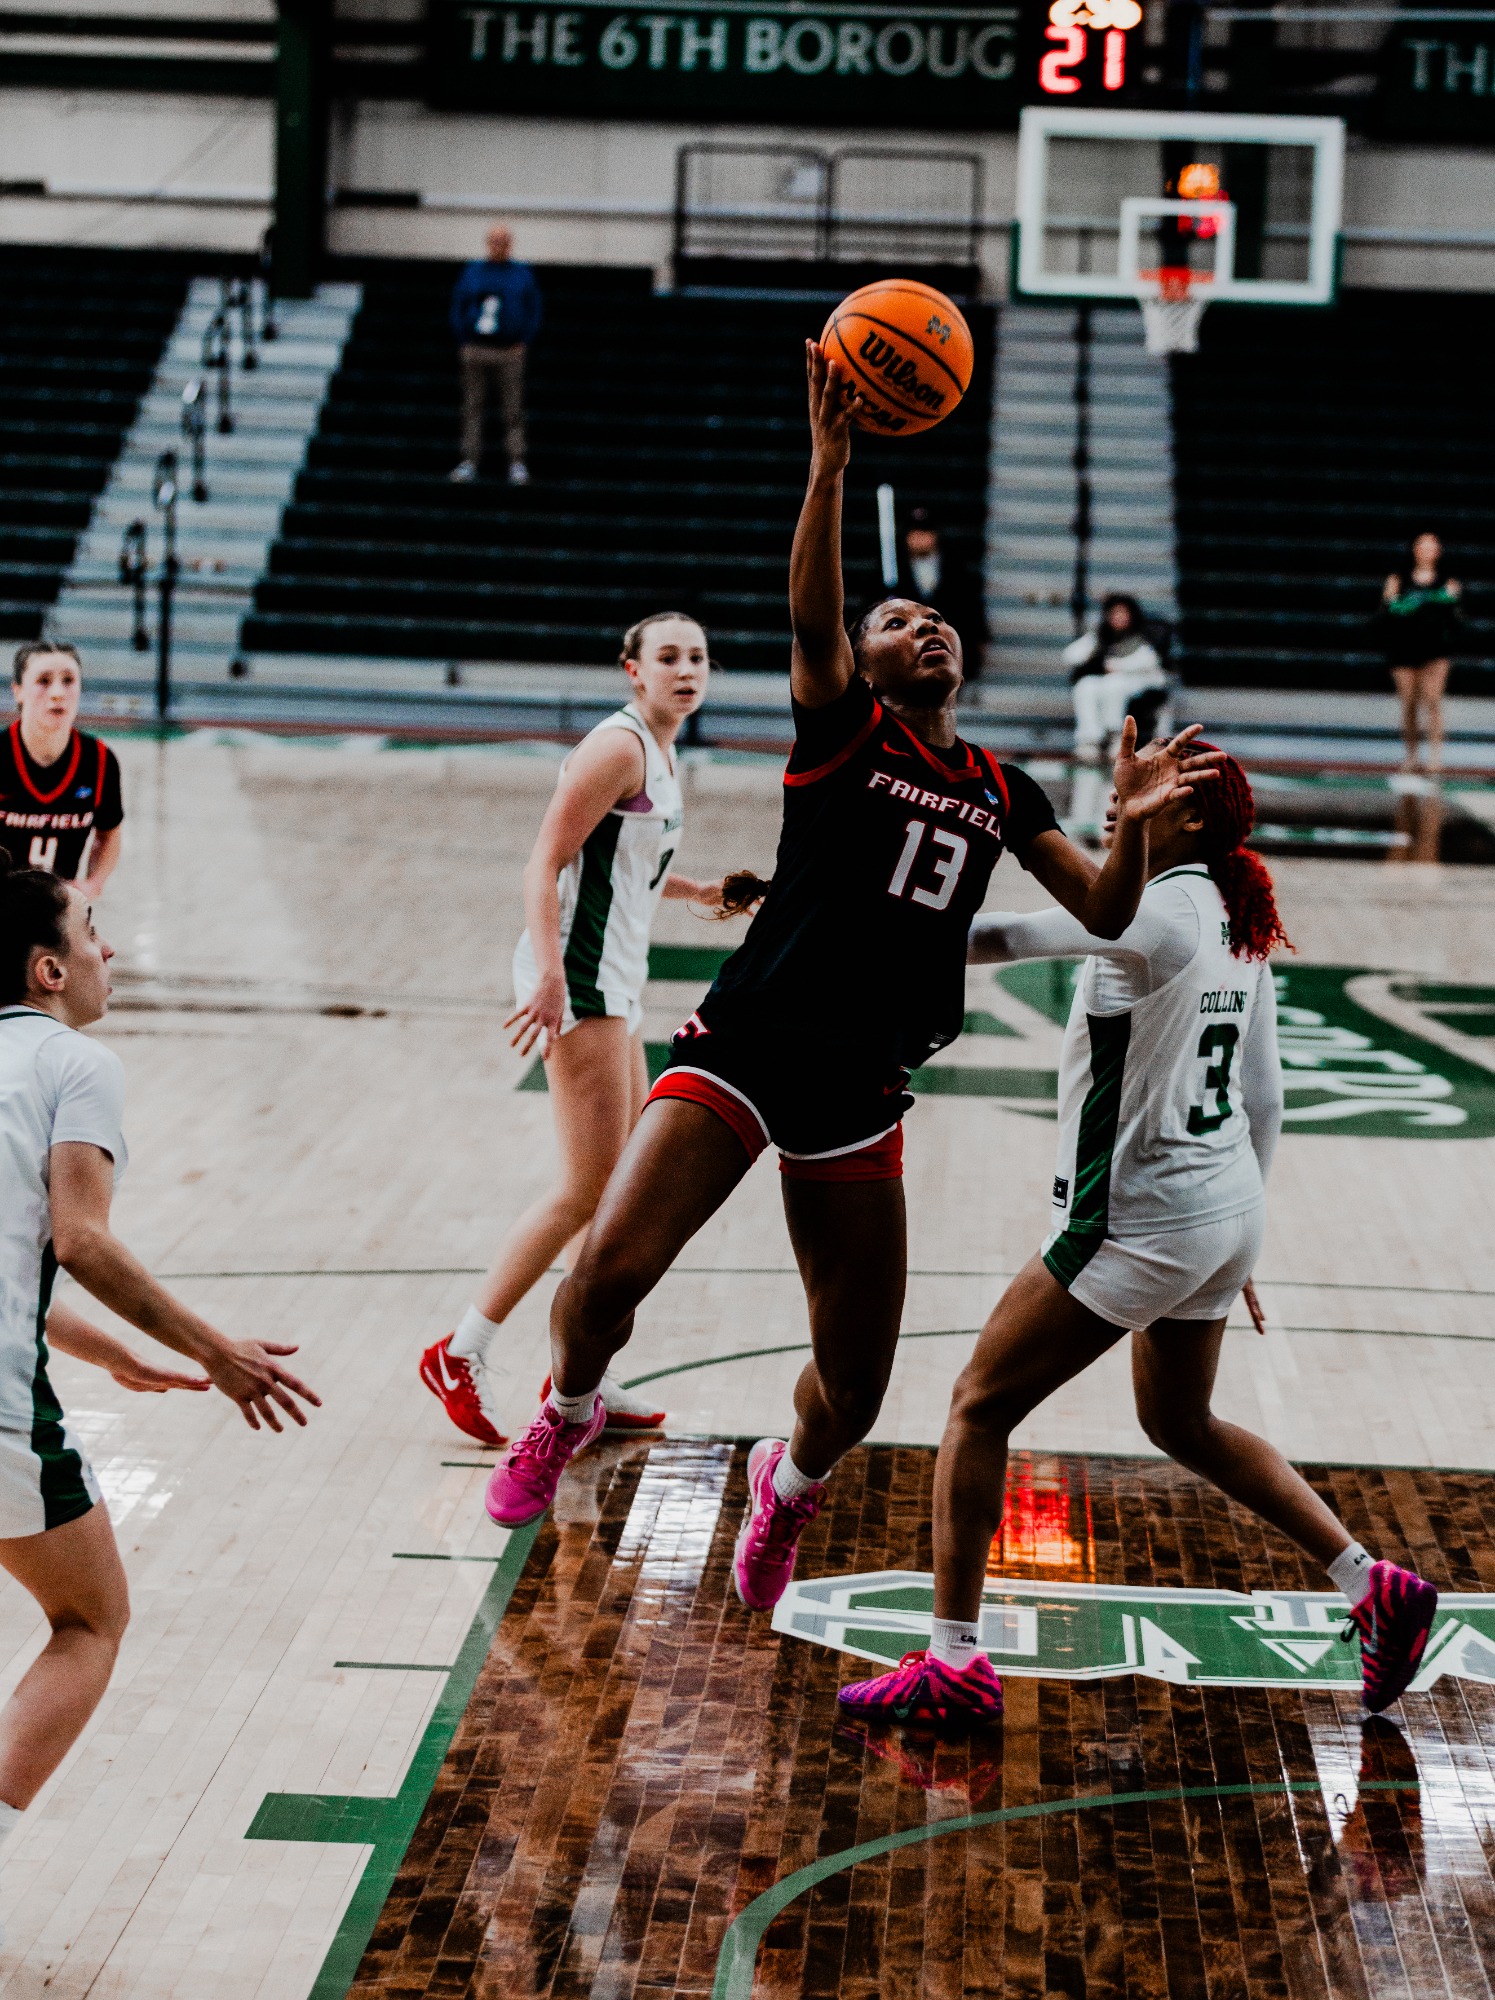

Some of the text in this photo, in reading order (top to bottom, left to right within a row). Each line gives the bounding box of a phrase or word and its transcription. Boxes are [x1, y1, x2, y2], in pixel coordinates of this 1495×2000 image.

[465, 9, 1016, 79] THE 6TH BOROUG
[1040, 24, 1125, 93] 21
[1402, 40, 1495, 95] TH
[860, 329, 945, 411] Wilson
[866, 769, 1002, 841] FAIRFIEL
[28, 835, 58, 874] 4
[887, 818, 968, 911] 13
[1185, 1022, 1240, 1137] 3
